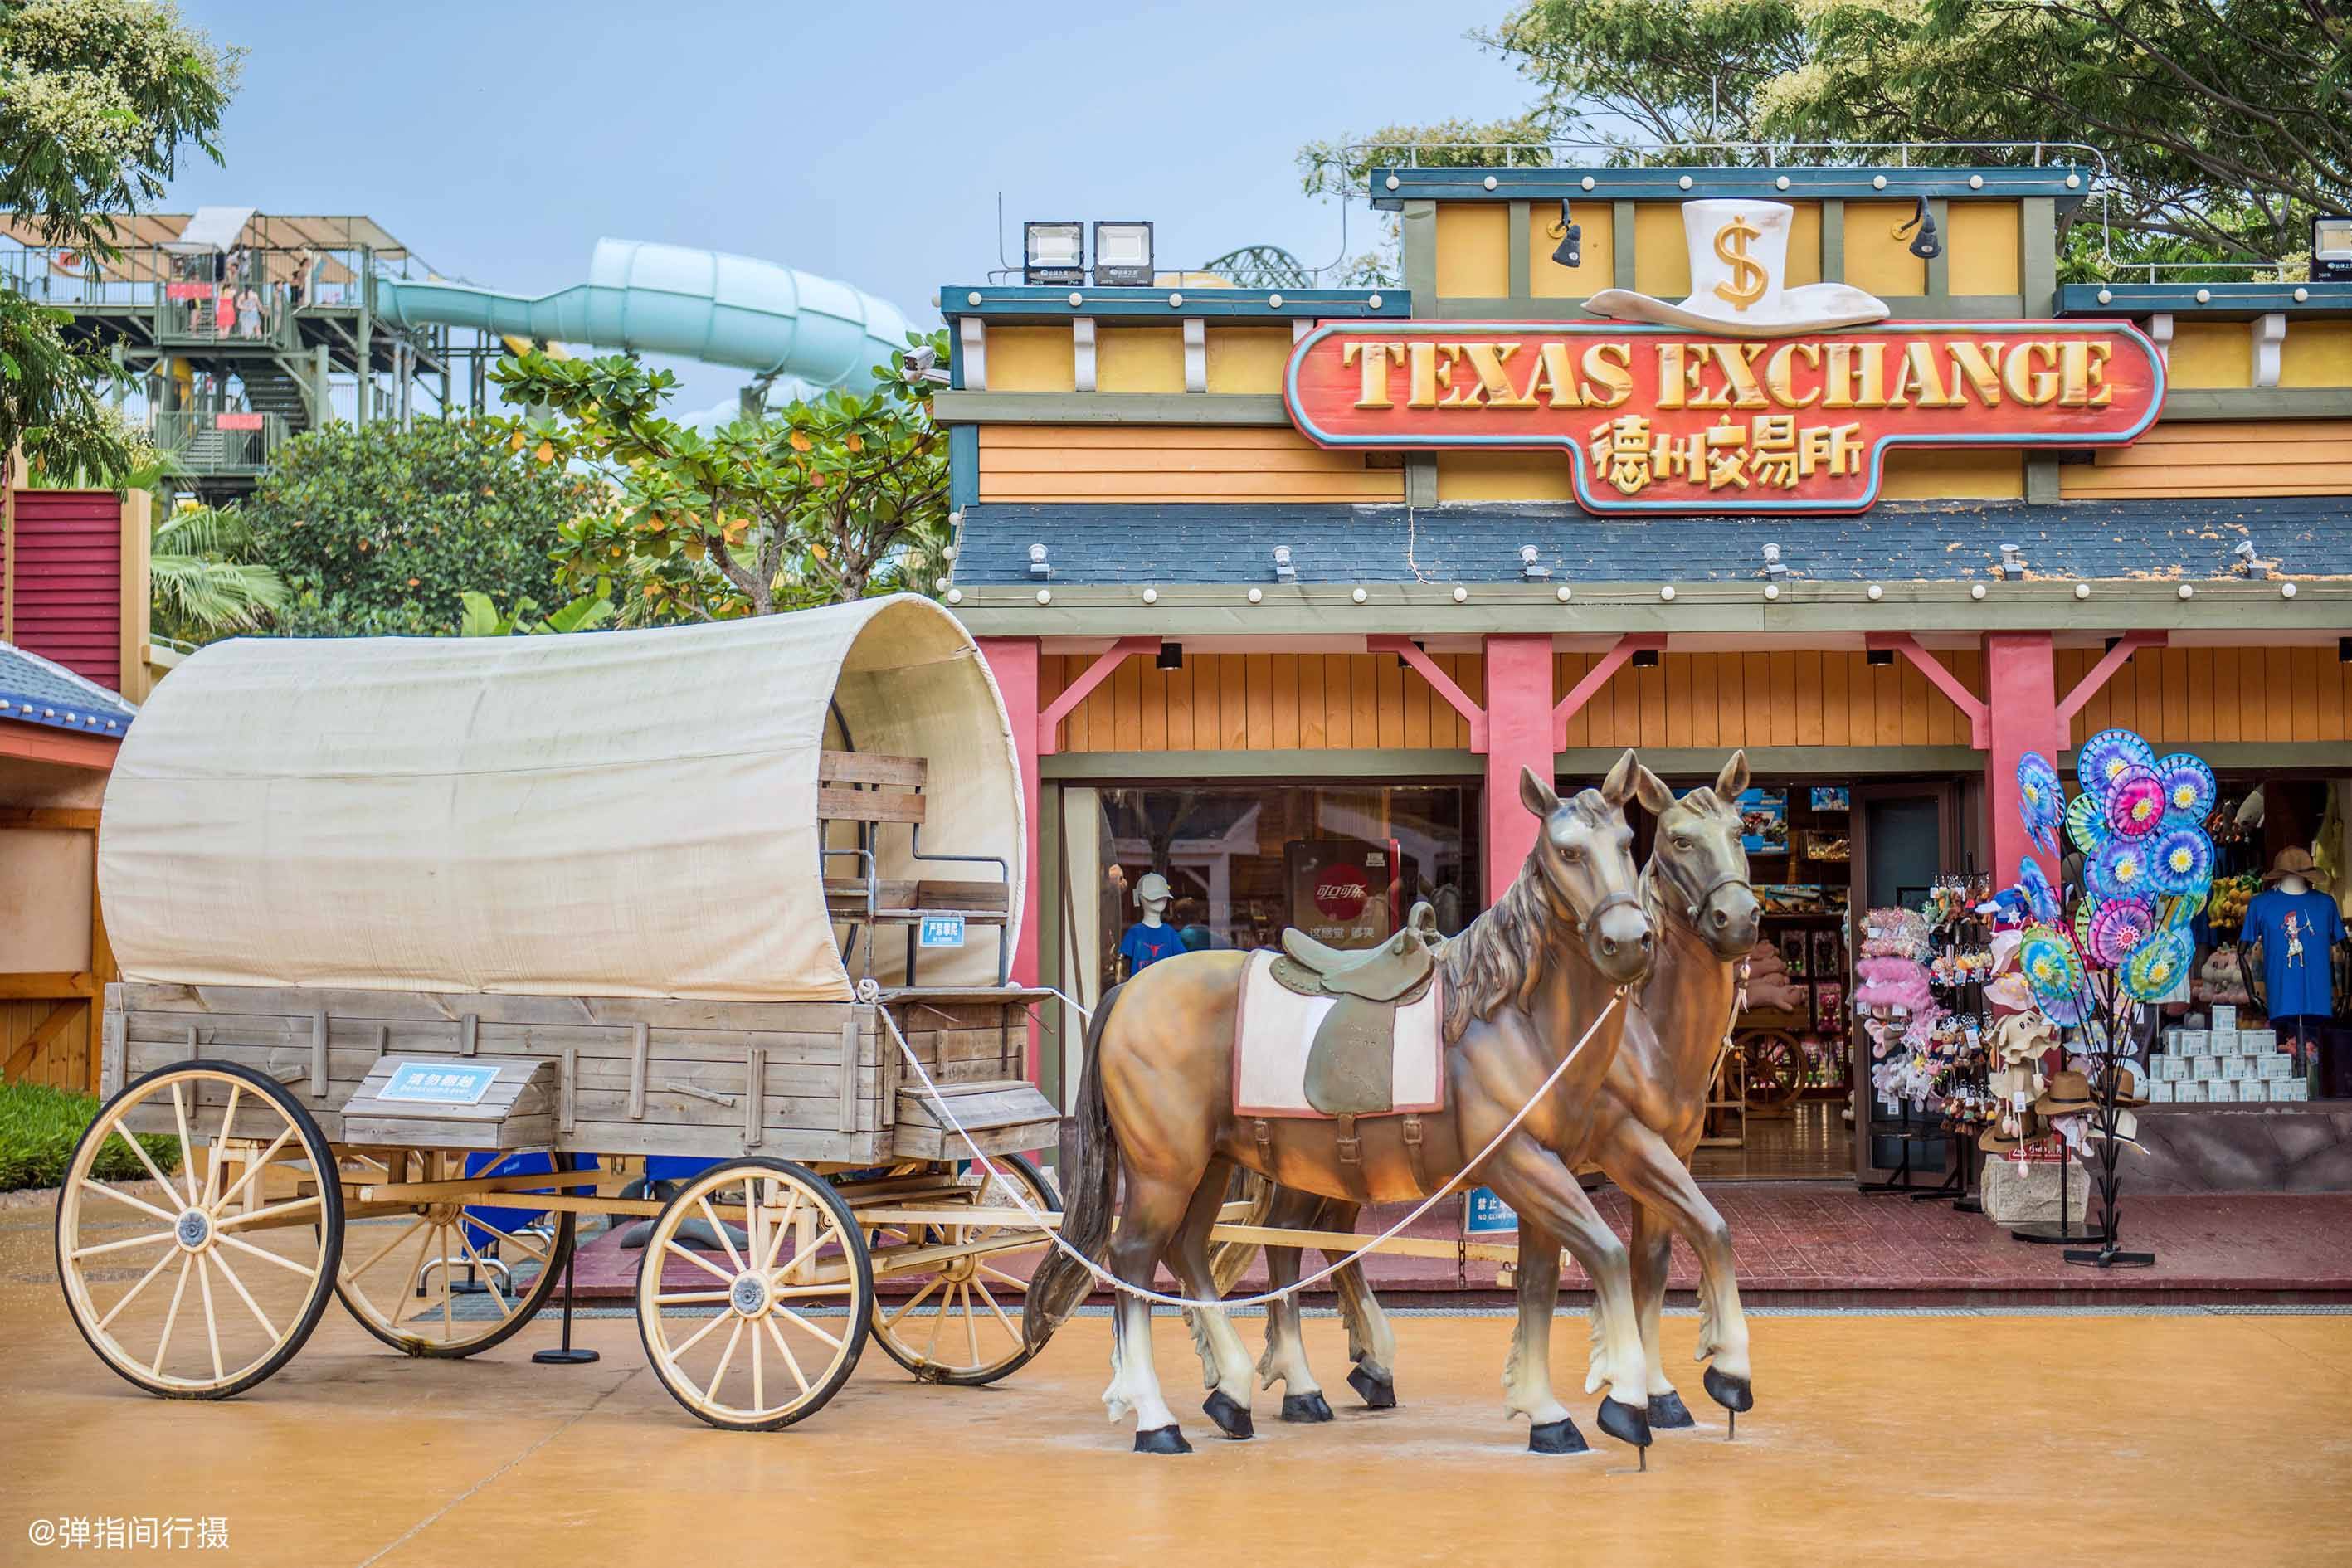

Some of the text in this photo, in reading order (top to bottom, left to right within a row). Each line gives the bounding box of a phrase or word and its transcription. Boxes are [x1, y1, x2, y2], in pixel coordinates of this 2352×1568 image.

[1342, 340, 2112, 410] TEXAS EXCHANGE
[1588, 413, 1865, 496] 德州交易所
[1316, 883, 1366, 901] 可口可乐
